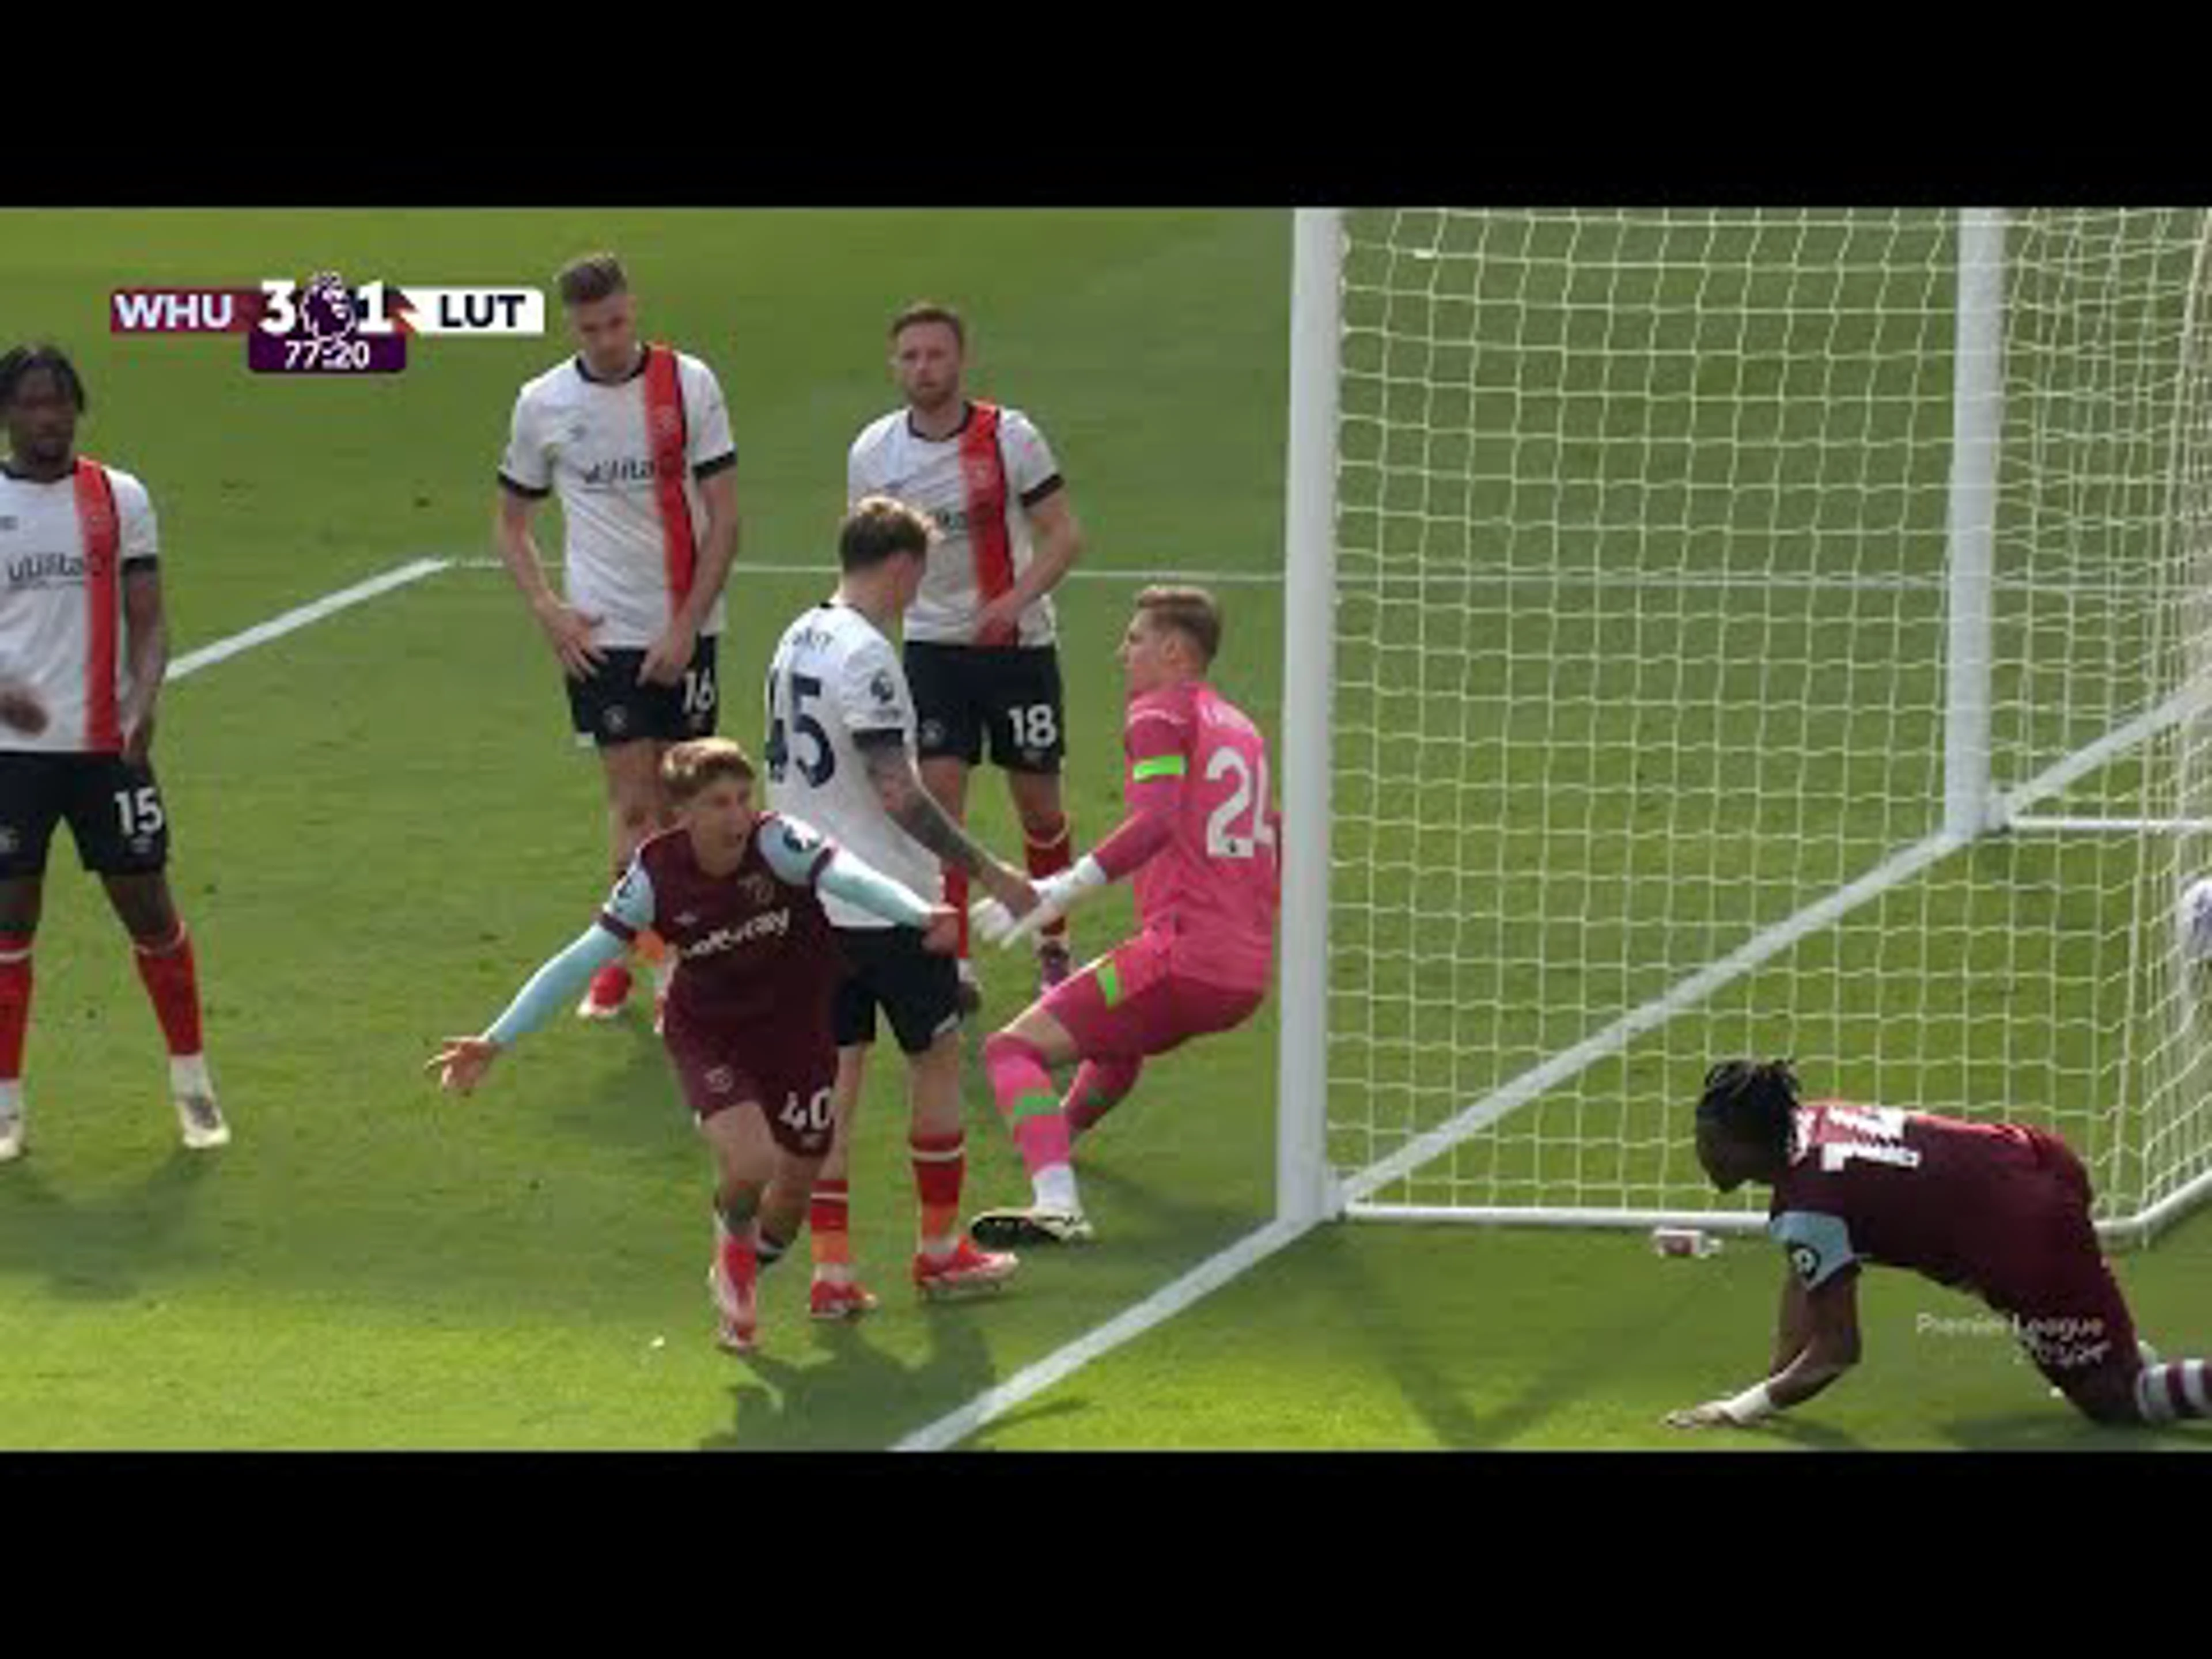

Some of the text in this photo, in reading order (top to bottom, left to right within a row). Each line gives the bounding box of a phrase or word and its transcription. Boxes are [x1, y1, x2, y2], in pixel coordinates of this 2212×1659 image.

[682, 671, 715, 714] 16
[1008, 704, 1058, 747] 18
[115, 787, 164, 836] 15
[778, 1087, 831, 1131] 40
